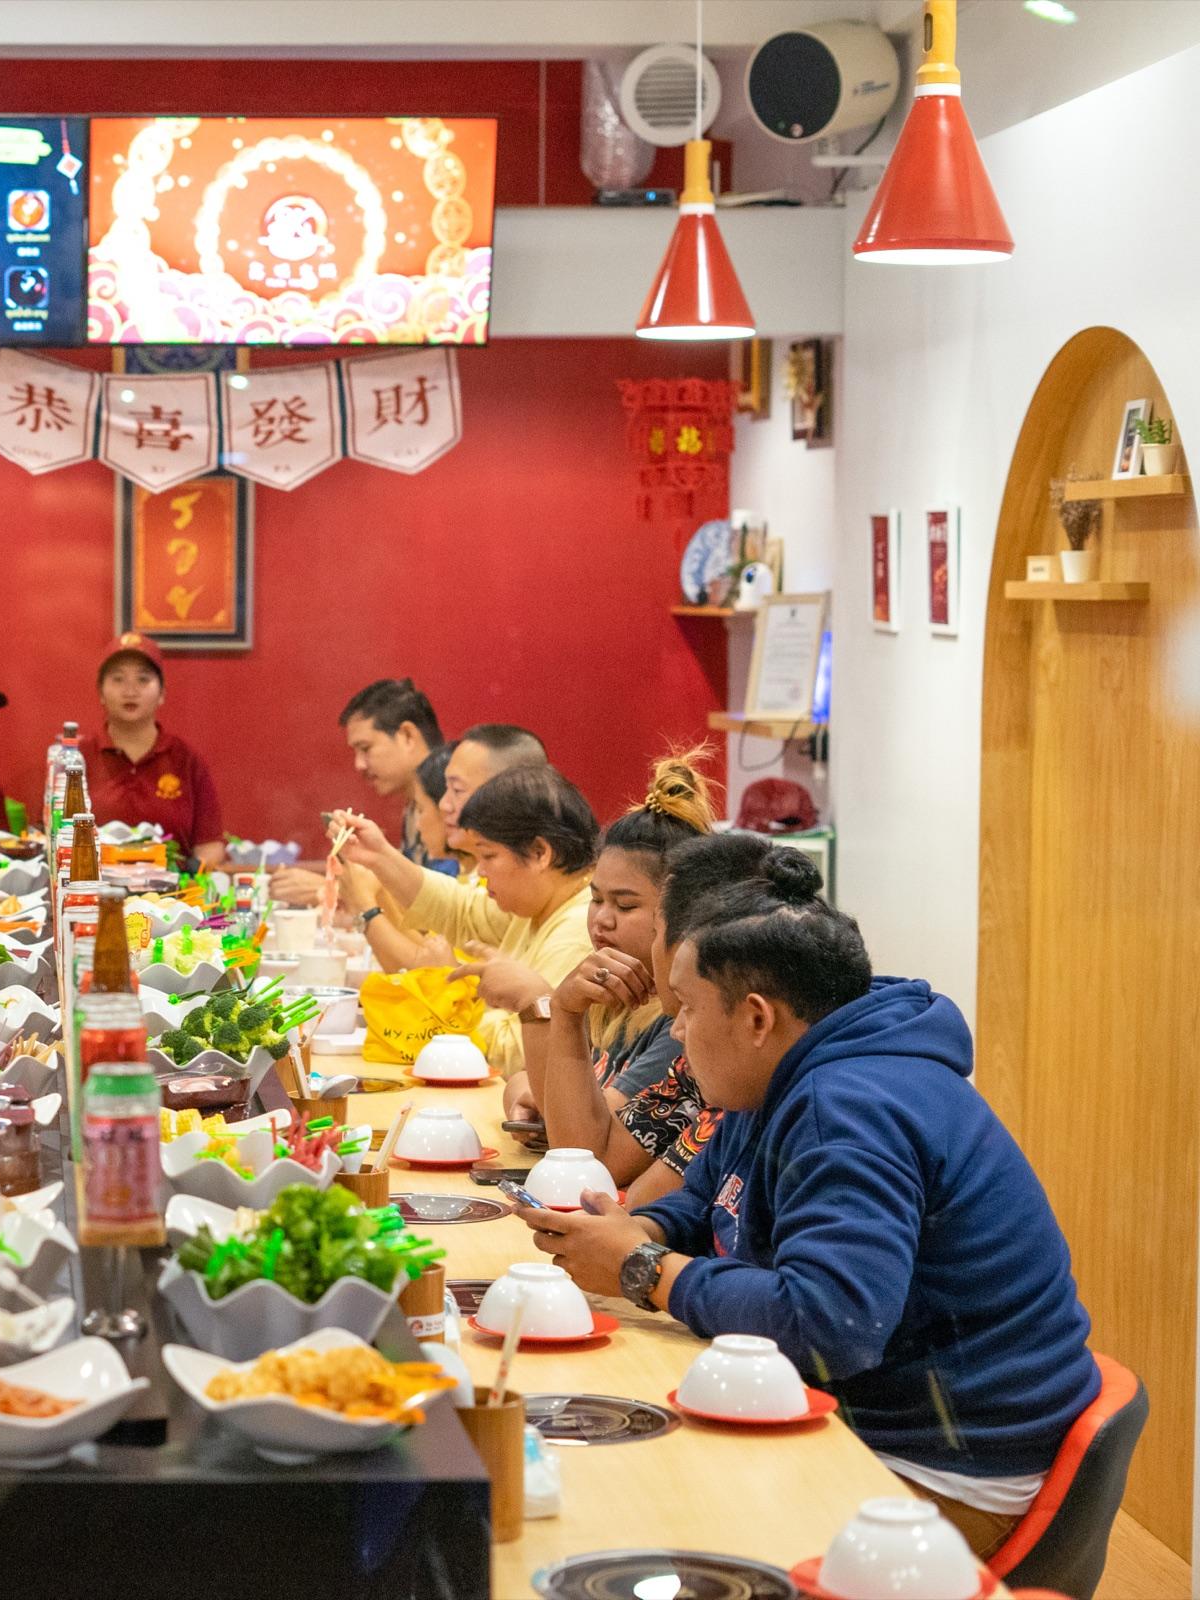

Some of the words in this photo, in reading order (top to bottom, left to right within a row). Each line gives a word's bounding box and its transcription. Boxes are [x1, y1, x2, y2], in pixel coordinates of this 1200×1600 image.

[0, 381, 77, 434] 恭
[123, 404, 195, 453] 喜
[237, 395, 316, 449] 發
[367, 374, 439, 437] 財
